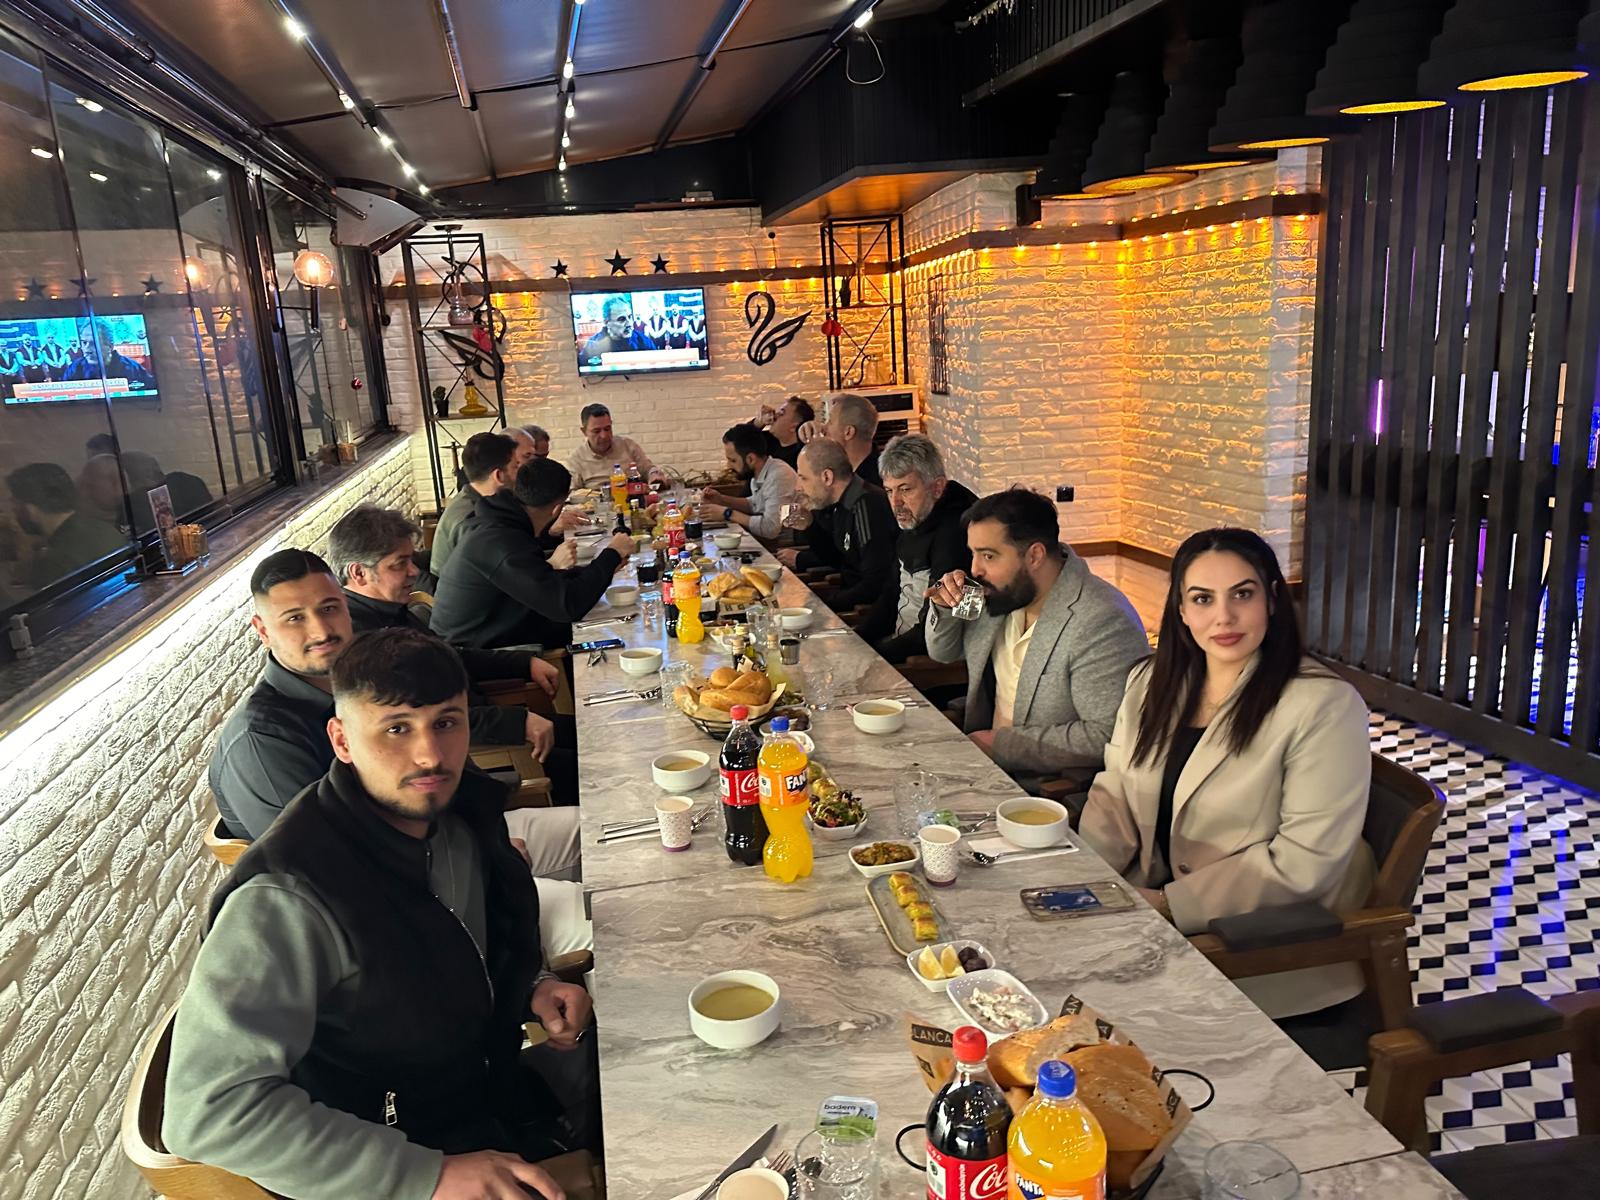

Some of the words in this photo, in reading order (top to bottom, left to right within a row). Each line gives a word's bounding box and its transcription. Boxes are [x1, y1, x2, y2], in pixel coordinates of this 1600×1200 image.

[741, 772, 759, 793] Coc
[785, 772, 807, 790] FAN
[913, 1027, 952, 1043] LANCA
[969, 1163, 1007, 1199] Coc
[1015, 1172, 1045, 1196] FANTA
